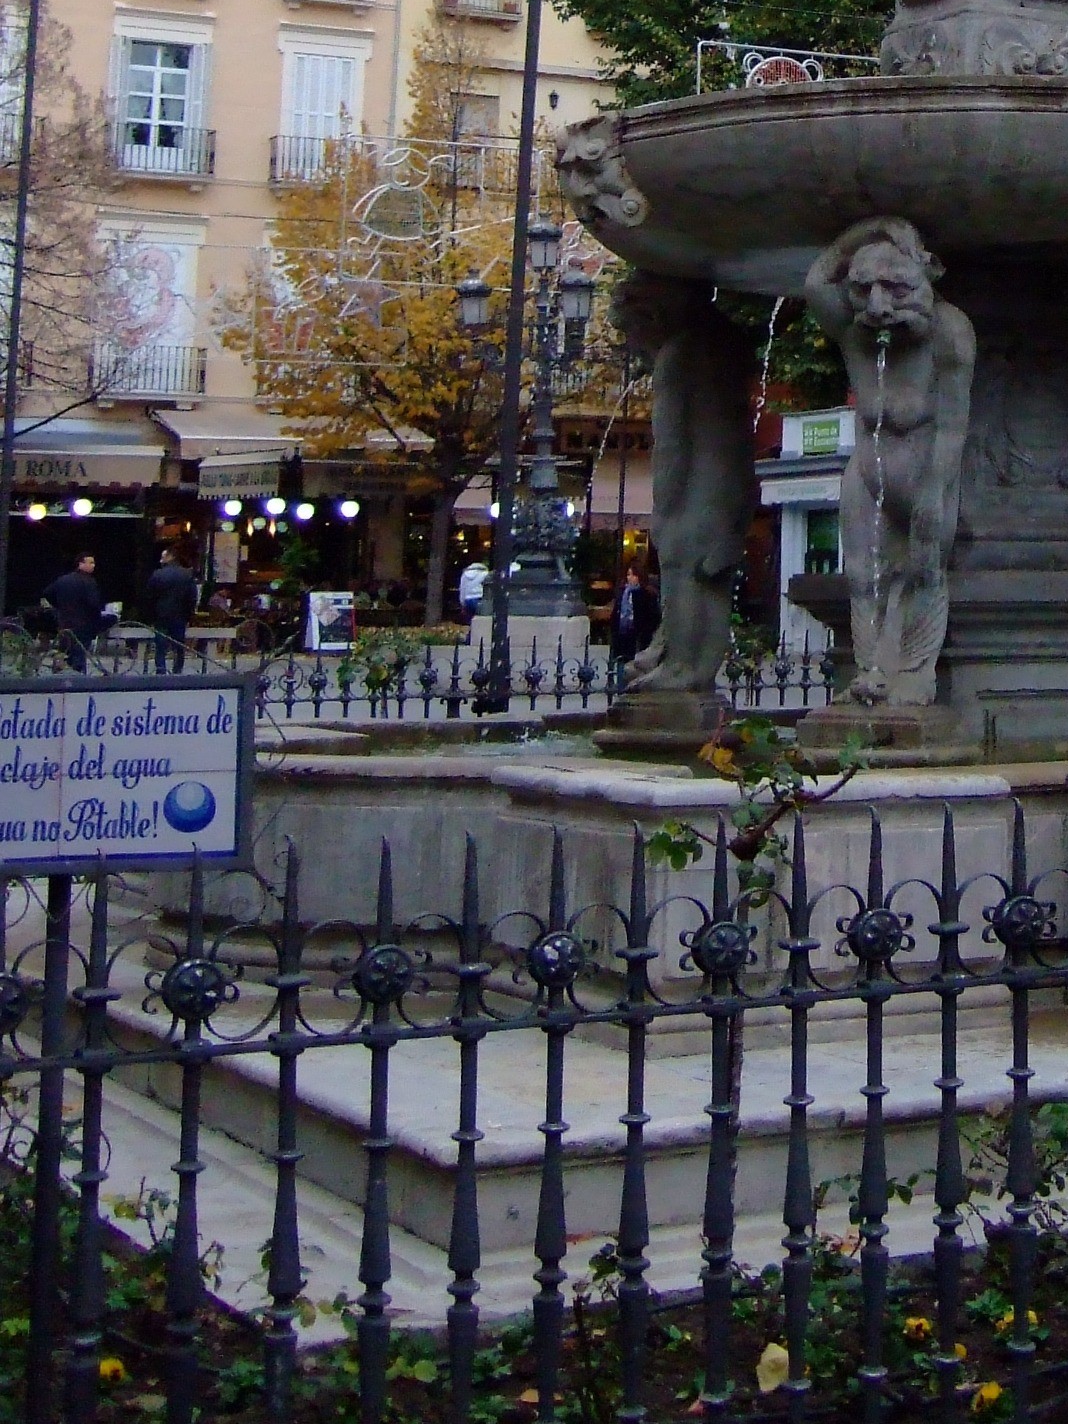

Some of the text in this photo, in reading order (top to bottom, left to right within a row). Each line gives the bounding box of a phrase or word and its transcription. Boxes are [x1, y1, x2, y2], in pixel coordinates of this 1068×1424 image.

[26, 459, 87, 477] ROMA
[0, 694, 233, 740] otada de sistema de
[68, 742, 107, 781] del
[112, 757, 172, 790] agua
[32, 820, 62, 842] no
[63, 796, 159, 842] Potable!
